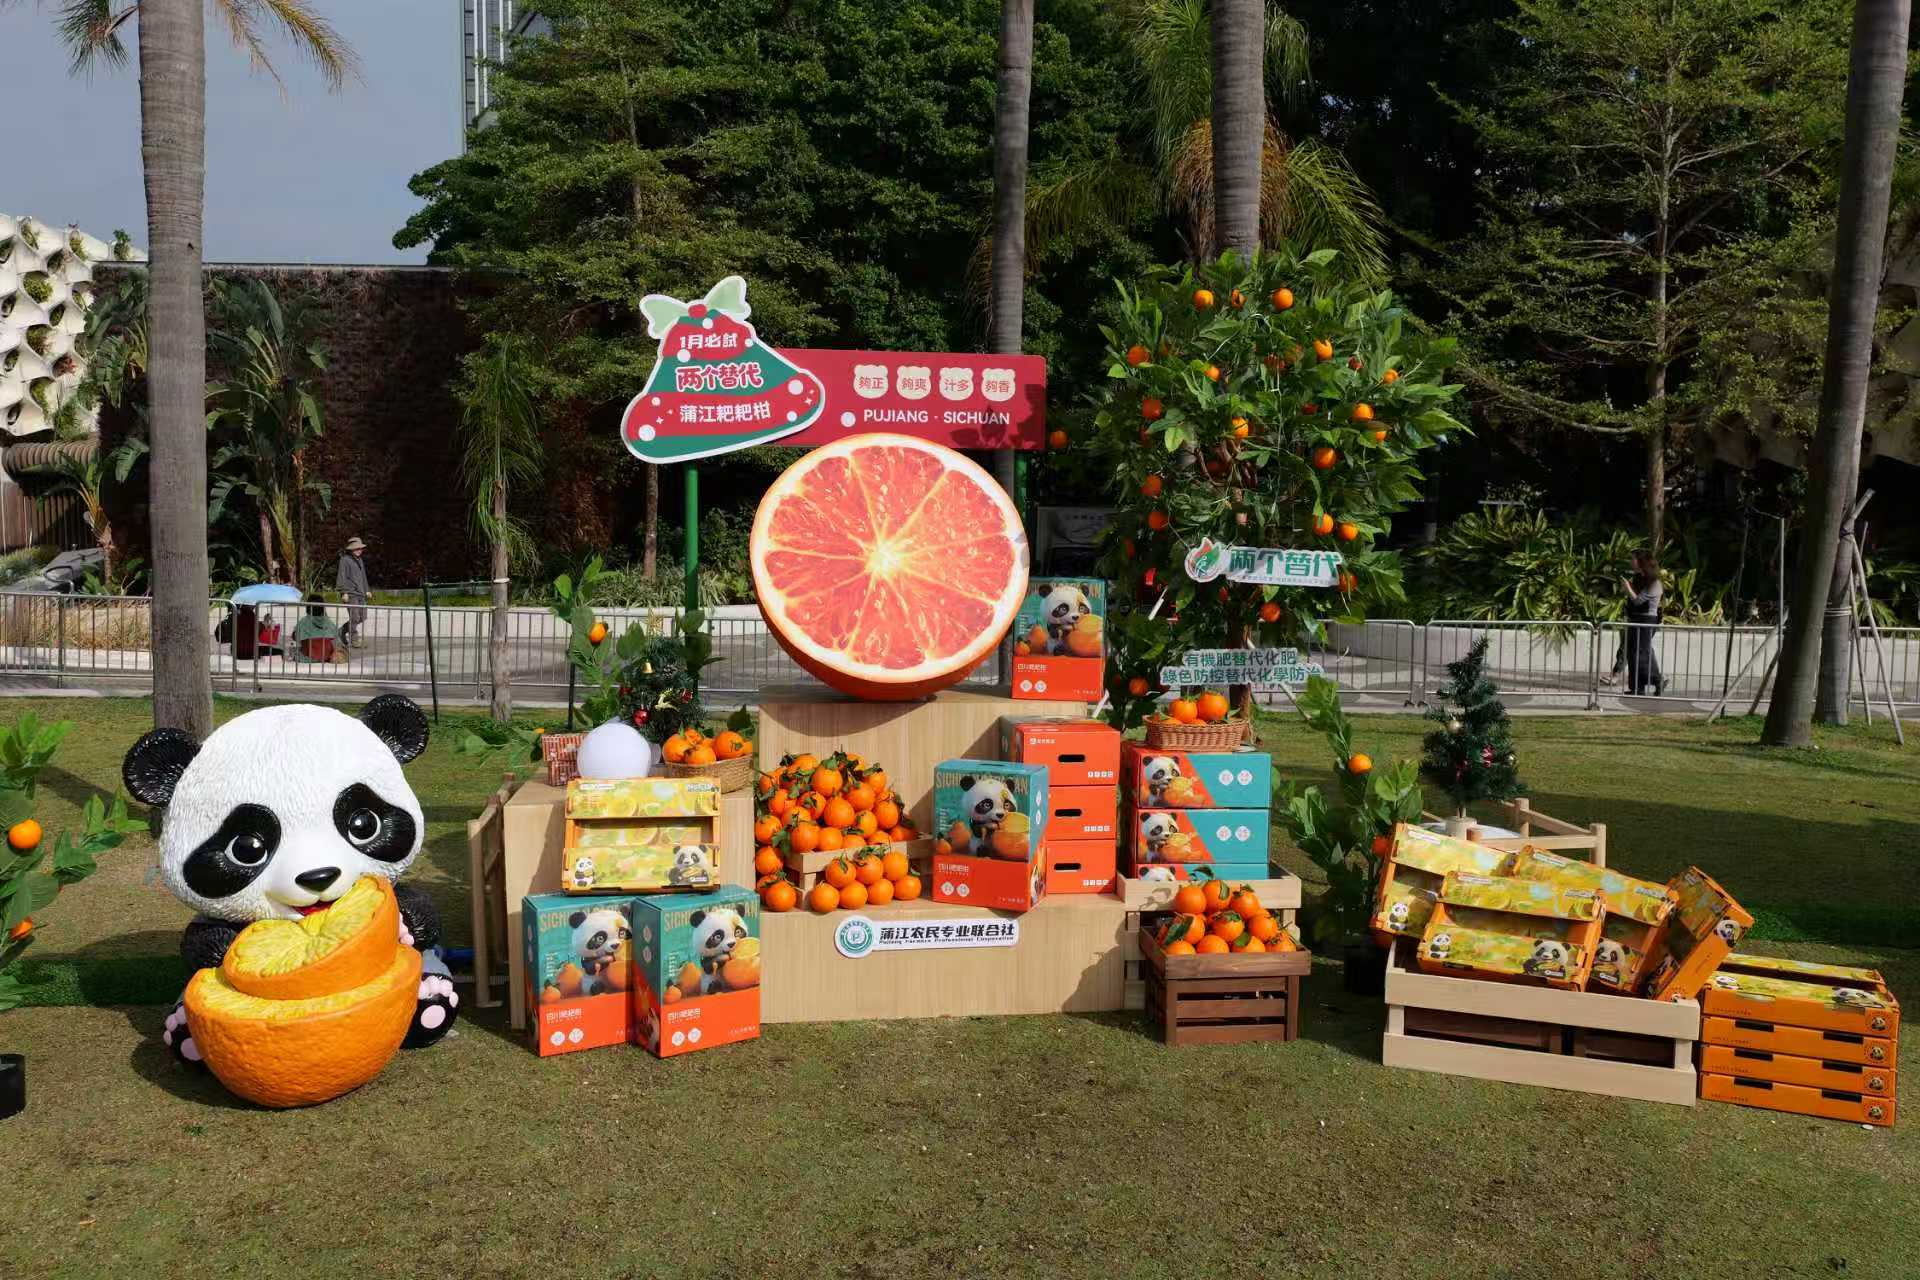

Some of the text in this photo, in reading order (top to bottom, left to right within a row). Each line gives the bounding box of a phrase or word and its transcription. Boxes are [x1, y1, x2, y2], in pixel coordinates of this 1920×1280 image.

[680, 333, 738, 349] 1月必試
[675, 362, 764, 392] 两个替代
[944, 378, 969, 391] 汁多
[679, 401, 772, 423] 蒲江耙耙柑
[863, 409, 1011, 425] PUJIANG SICHUAN
[1229, 549, 1342, 578] 两个替代
[1185, 650, 1297, 668] 有機肥替代化肥
[880, 923, 1015, 940] 蒲江农民专业联合社
